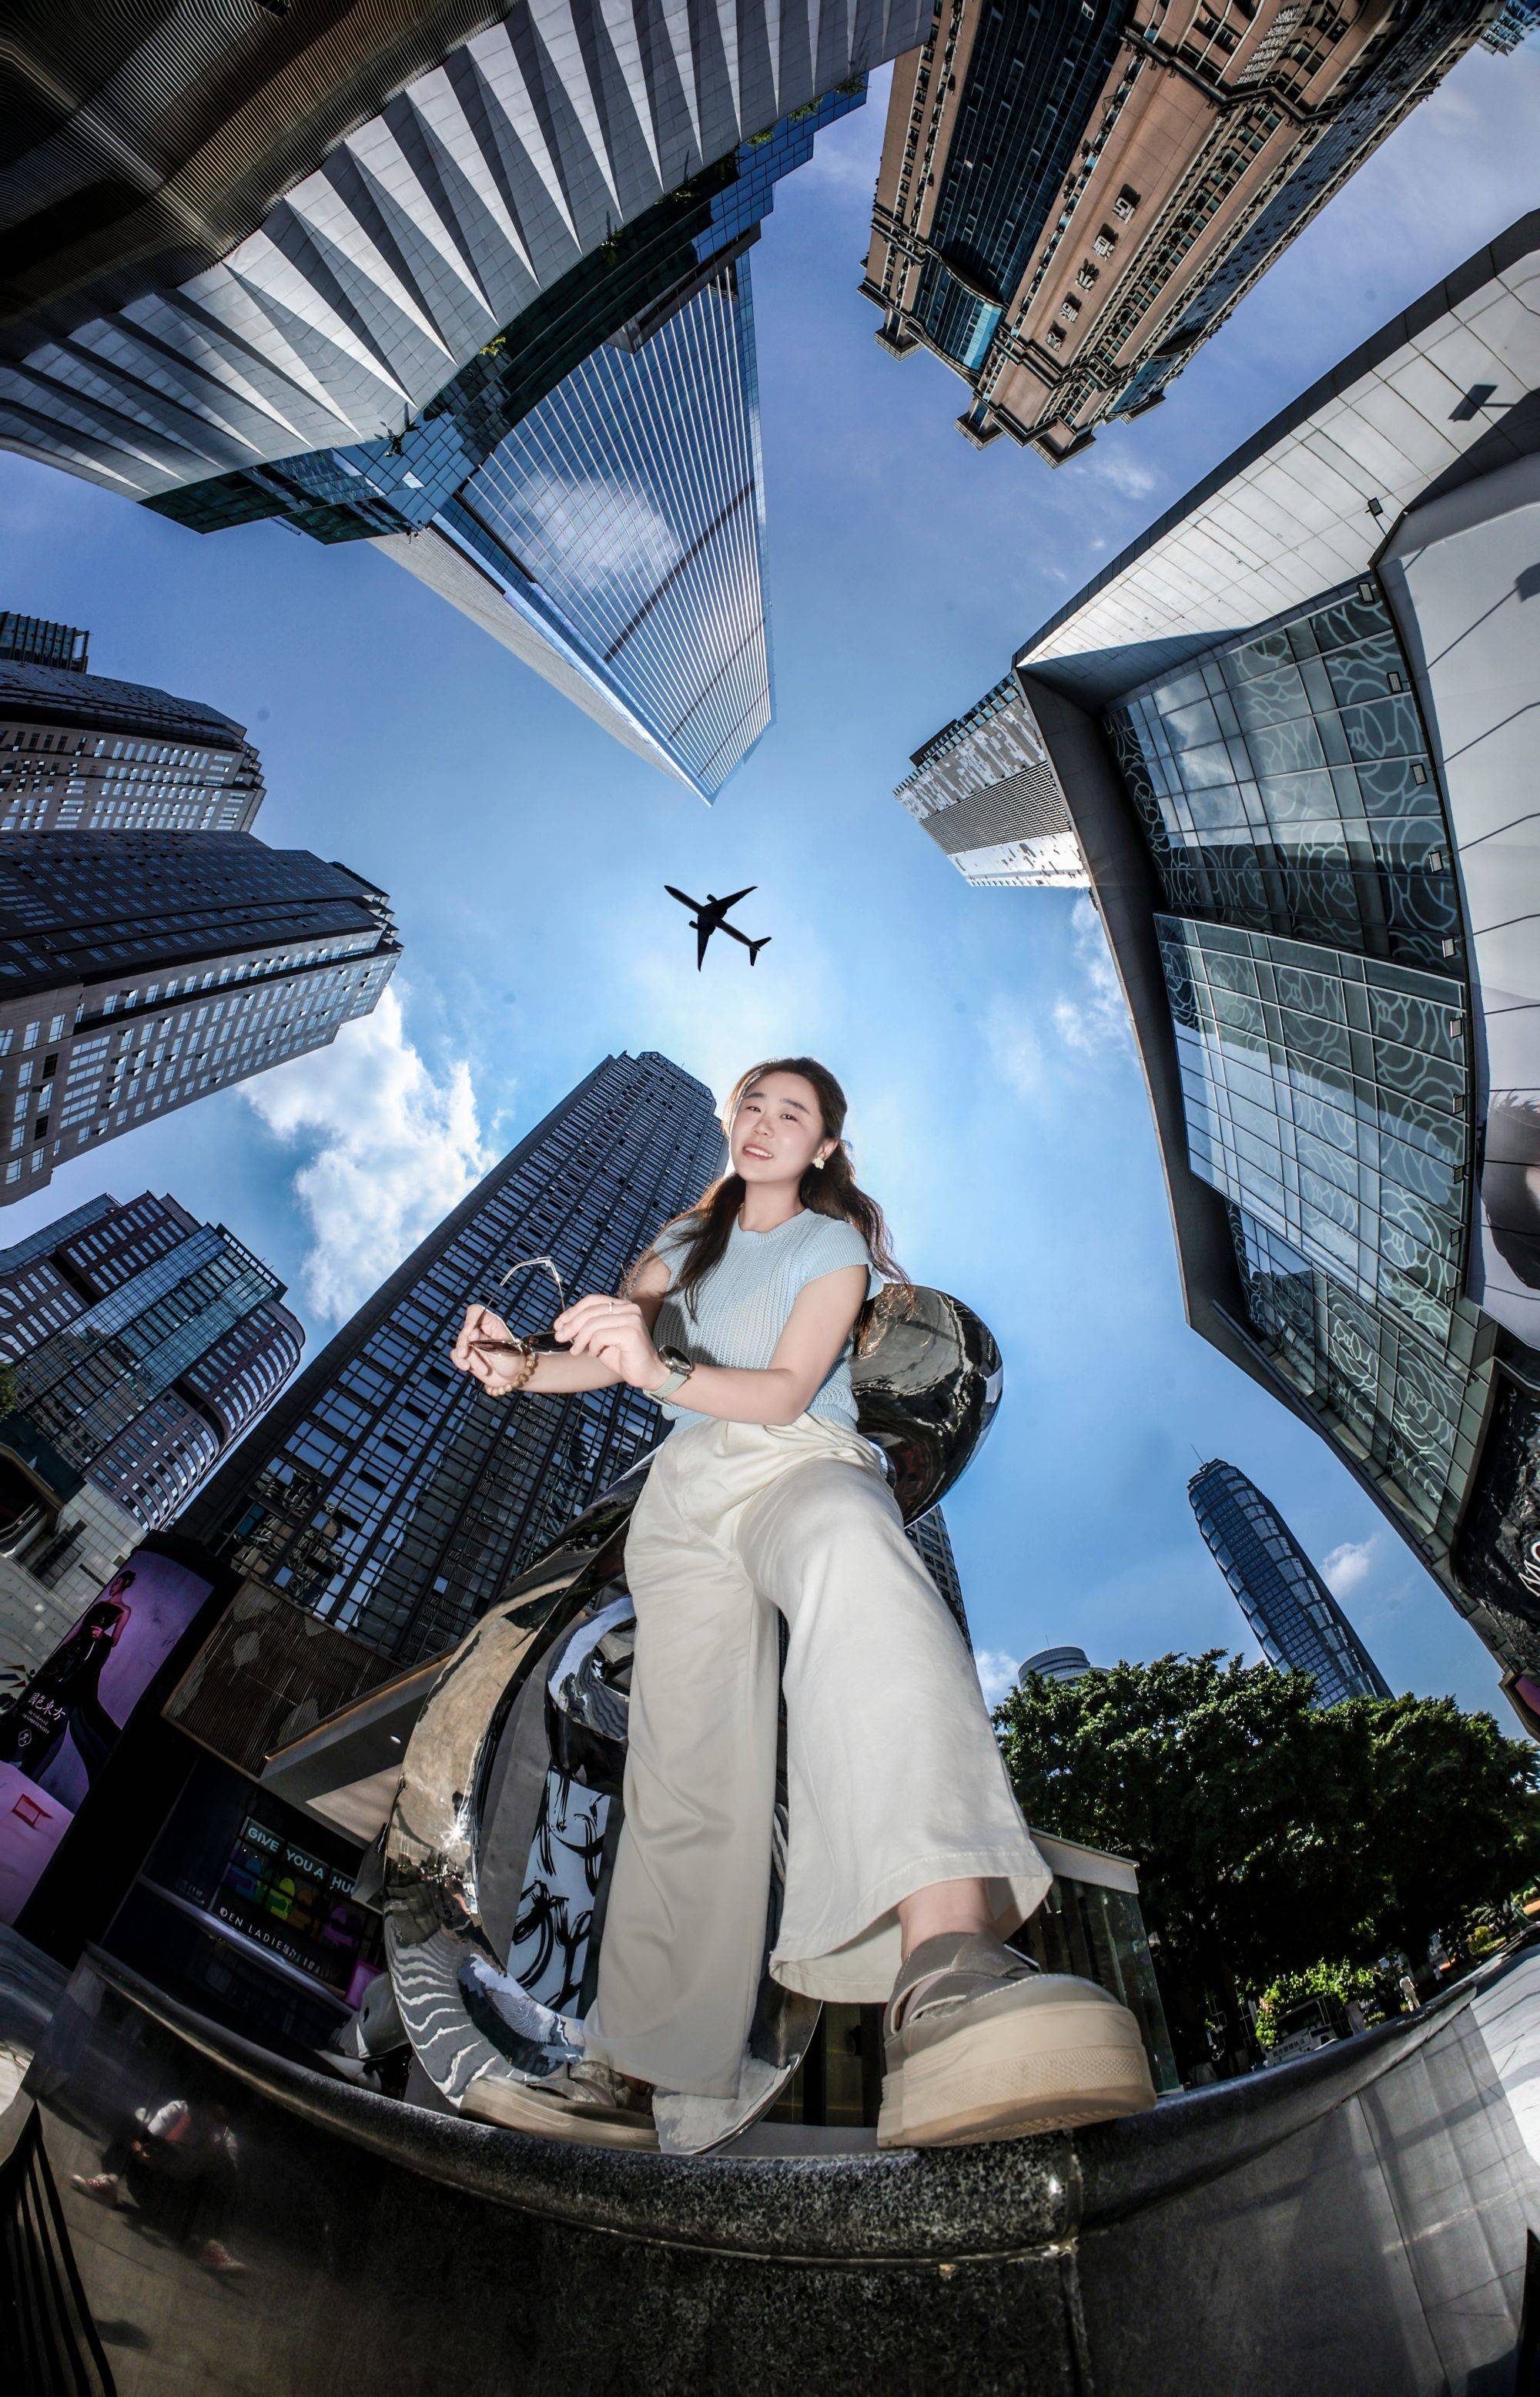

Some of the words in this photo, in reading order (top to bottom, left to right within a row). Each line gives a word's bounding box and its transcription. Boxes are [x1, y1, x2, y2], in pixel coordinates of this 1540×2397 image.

[247, 1827, 280, 1853] GIVE
[285, 1849, 313, 1872] YOU
[313, 1867, 325, 1879] A
